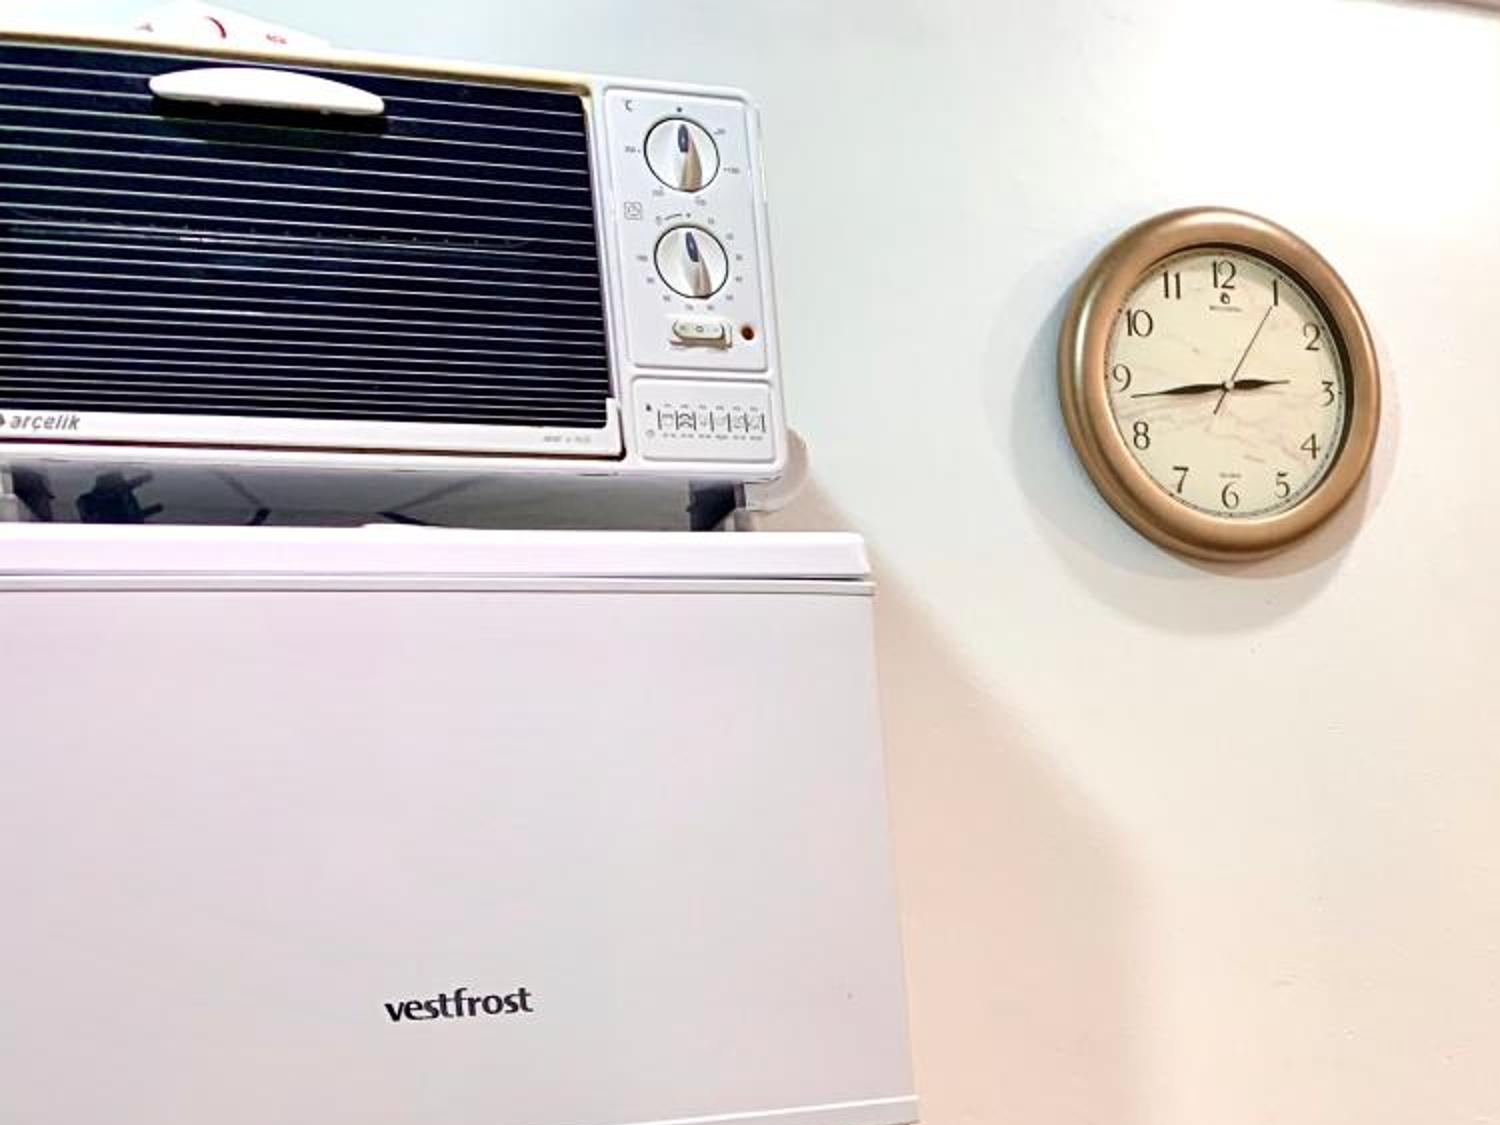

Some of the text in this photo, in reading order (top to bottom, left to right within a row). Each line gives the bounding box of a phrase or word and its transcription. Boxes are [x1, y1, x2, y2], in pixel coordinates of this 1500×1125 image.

[1163, 271, 1182, 300] 11
[1212, 260, 1236, 289] 12
[1272, 279, 1279, 307] 1
[1126, 309, 1154, 337] 10
[1303, 323, 1321, 351] 2
[1112, 364, 1132, 392] 9
[1321, 380, 1335, 407] 3
[1133, 421, 1150, 450] 8
[1300, 432, 1321, 460] 4
[1172, 466, 1189, 493] 7
[1275, 472, 1291, 499] 5
[1221, 481, 1240, 510] 6
[384, 987, 534, 1022] vestfrost
